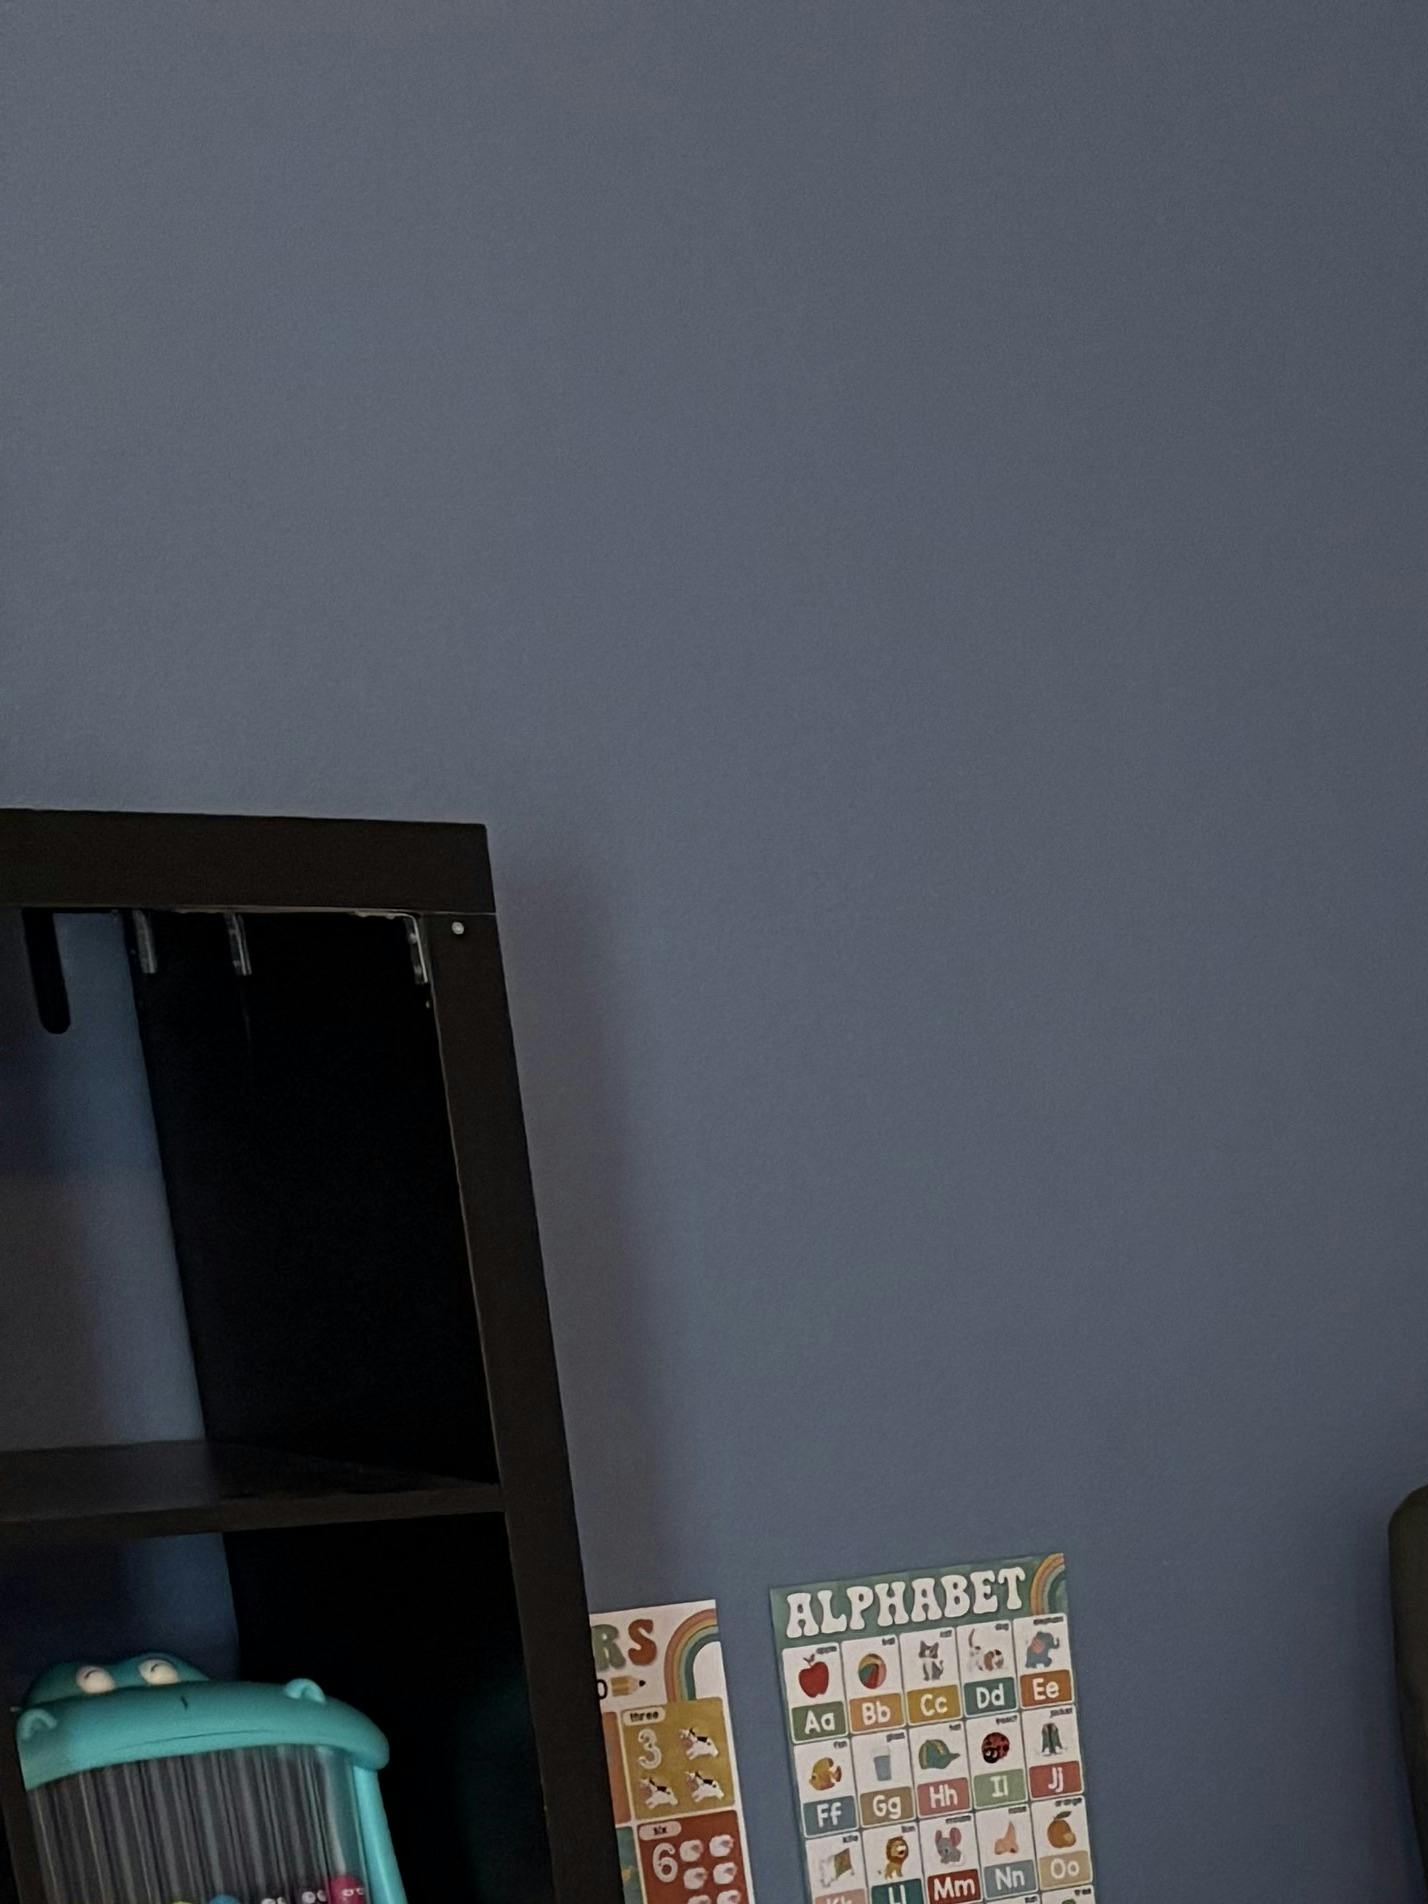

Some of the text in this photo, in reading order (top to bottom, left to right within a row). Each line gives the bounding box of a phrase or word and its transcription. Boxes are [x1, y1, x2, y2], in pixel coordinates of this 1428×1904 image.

[786, 1567, 1026, 1638] ALPHABET
[804, 1678, 1060, 1735] Aa Bb Cc Dd Ee
[638, 1729, 662, 1770] 3
[652, 1842, 678, 1882] 6
[933, 1869, 1025, 1900] Mm Nn
